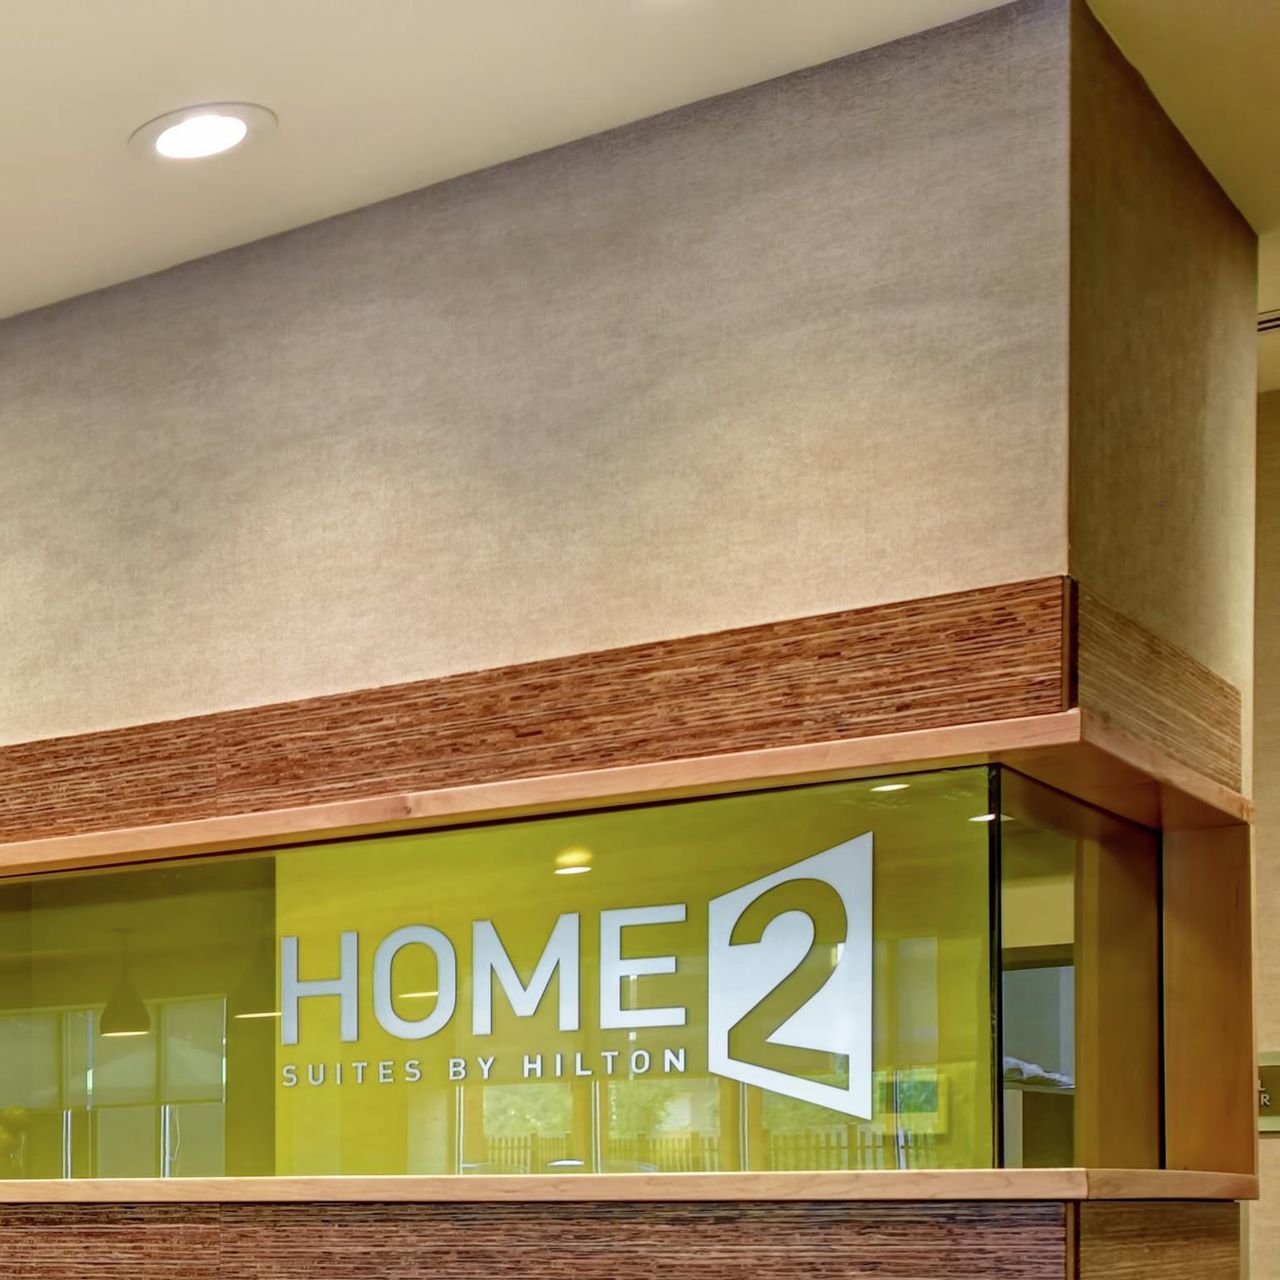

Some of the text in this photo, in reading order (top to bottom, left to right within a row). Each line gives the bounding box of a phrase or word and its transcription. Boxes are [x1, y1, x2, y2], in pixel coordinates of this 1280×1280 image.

[280, 877, 851, 1092] HOME 2
[281, 1047, 686, 1088] SUITES BY HILTON
